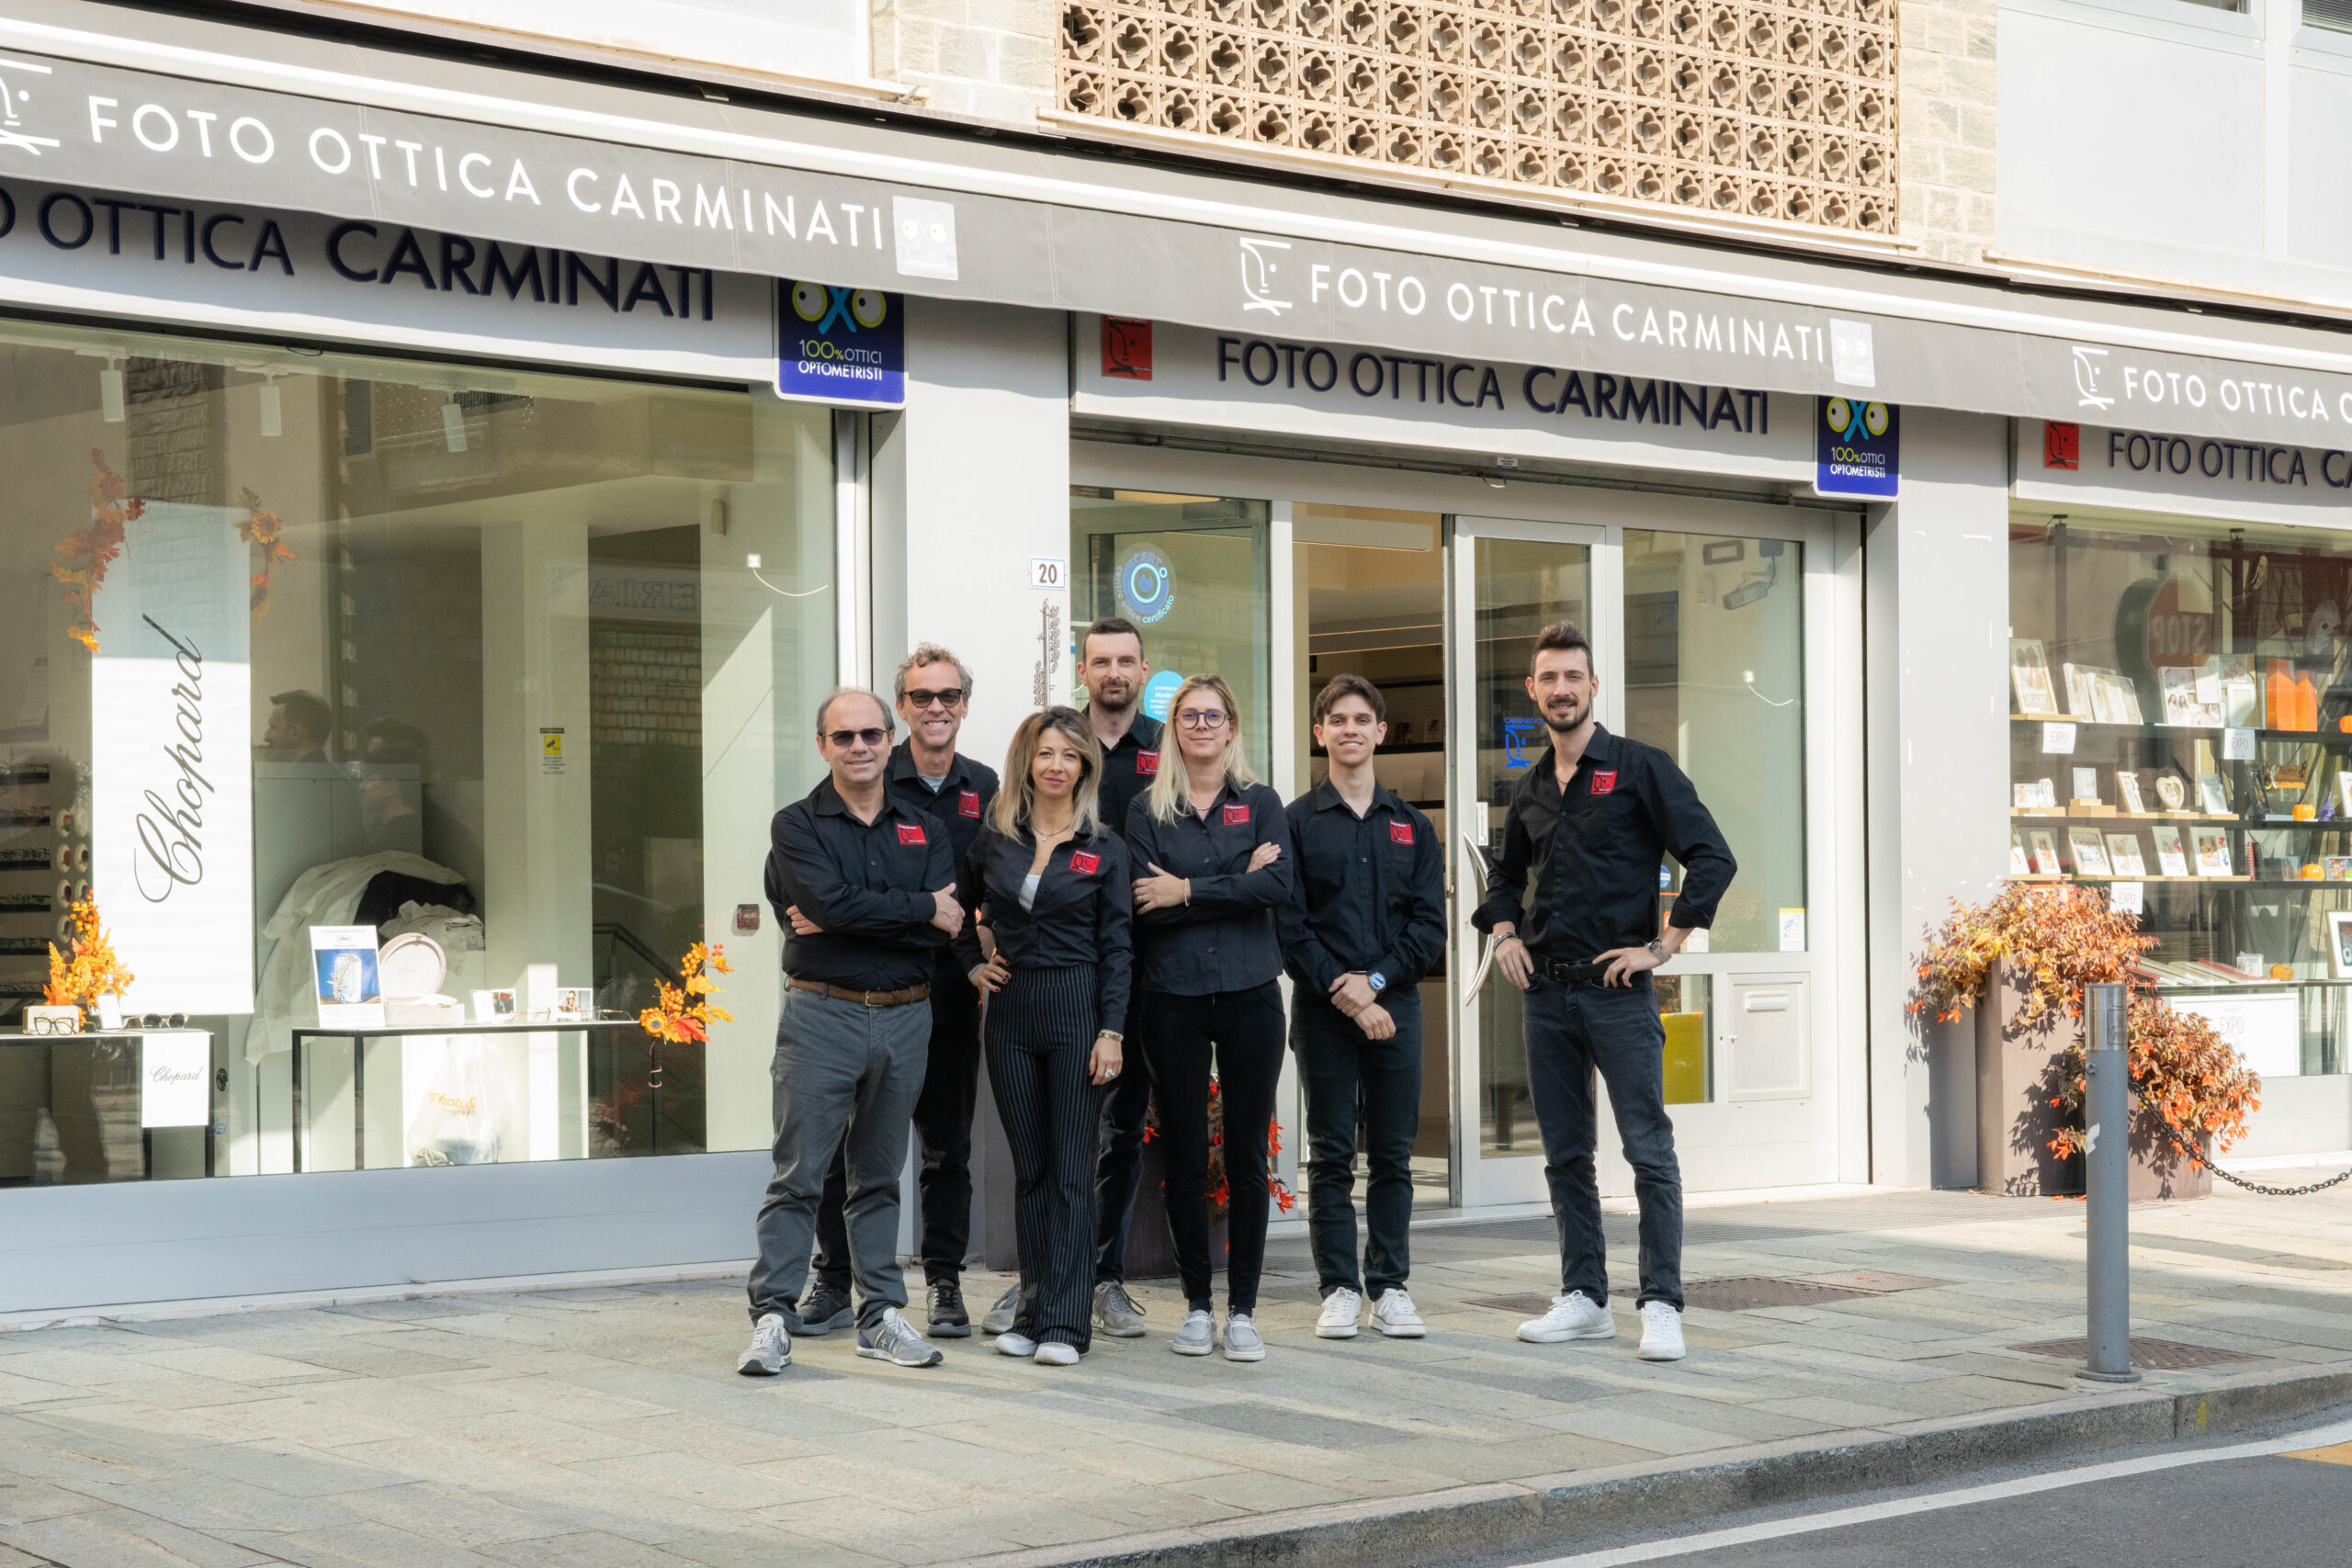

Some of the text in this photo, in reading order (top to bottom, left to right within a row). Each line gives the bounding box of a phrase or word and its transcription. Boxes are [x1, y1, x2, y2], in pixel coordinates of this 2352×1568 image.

[88, 96, 882, 250] FOTO OTTICA CARMINATI
[38, 191, 295, 276] OTTICA
[325, 221, 714, 321] CARMINATI
[1311, 264, 1824, 362] FOTO OTTICA CARMINATI
[798, 360, 883, 380] OPTOMETRISTI
[1218, 336, 1768, 434] FOTO OTTICA CARMINATI
[2123, 367, 2206, 407] FOTO
[2220, 378, 2330, 421] OTTICA
[1830, 464, 1885, 478] OPTOMETRISTI
[2108, 431, 2191, 474] FOTO
[2199, 440, 2308, 486] OTTICA
[1038, 563, 1057, 584] 20
[1142, 594, 1174, 624] certificato
[134, 613, 215, 904] Chopard
[2232, 737, 2248, 750] EXPO
[2219, 1016, 2244, 1034] EXPO
[149, 1066, 204, 1085] Chopard
